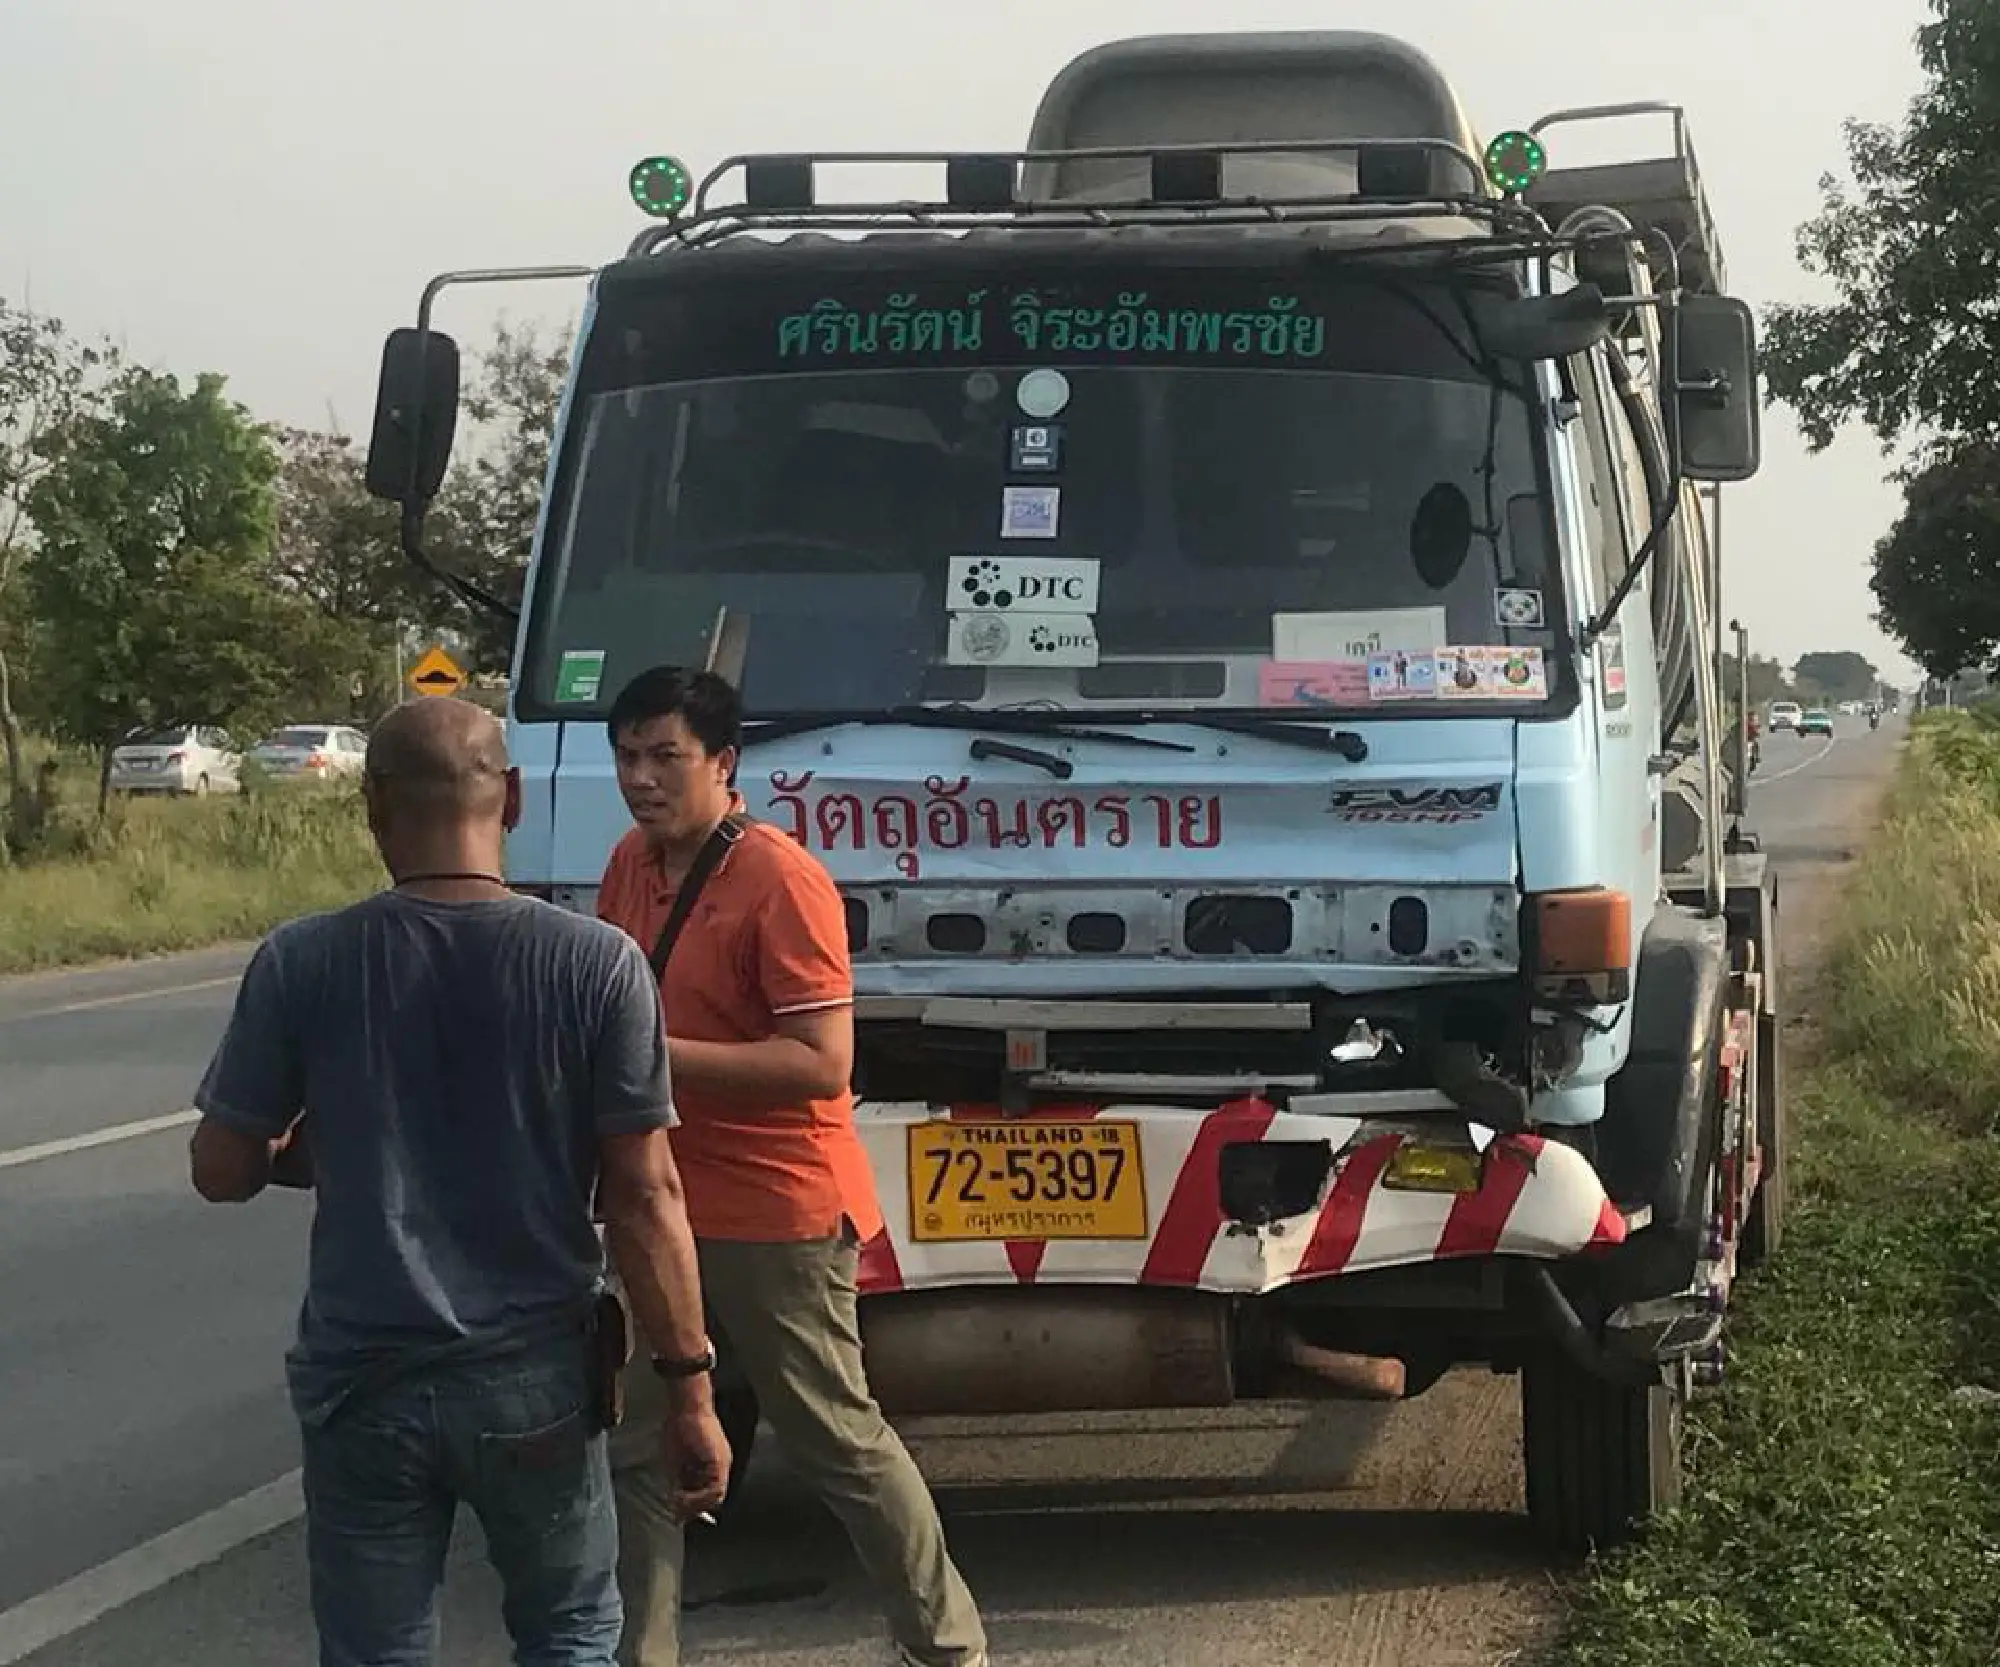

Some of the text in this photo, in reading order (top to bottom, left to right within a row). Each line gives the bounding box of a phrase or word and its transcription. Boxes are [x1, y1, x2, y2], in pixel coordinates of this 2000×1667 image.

[779, 289, 1325, 356] ศรินรัตน์ จิระอัมพรชัย
[1017, 576, 1084, 600] DTC
[1058, 634, 1093, 648] DTC
[767, 770, 1222, 880] วัตถุอันตราย
[962, 1128, 1084, 1144] THAILAND
[924, 1149, 1125, 1205] 72-5397
